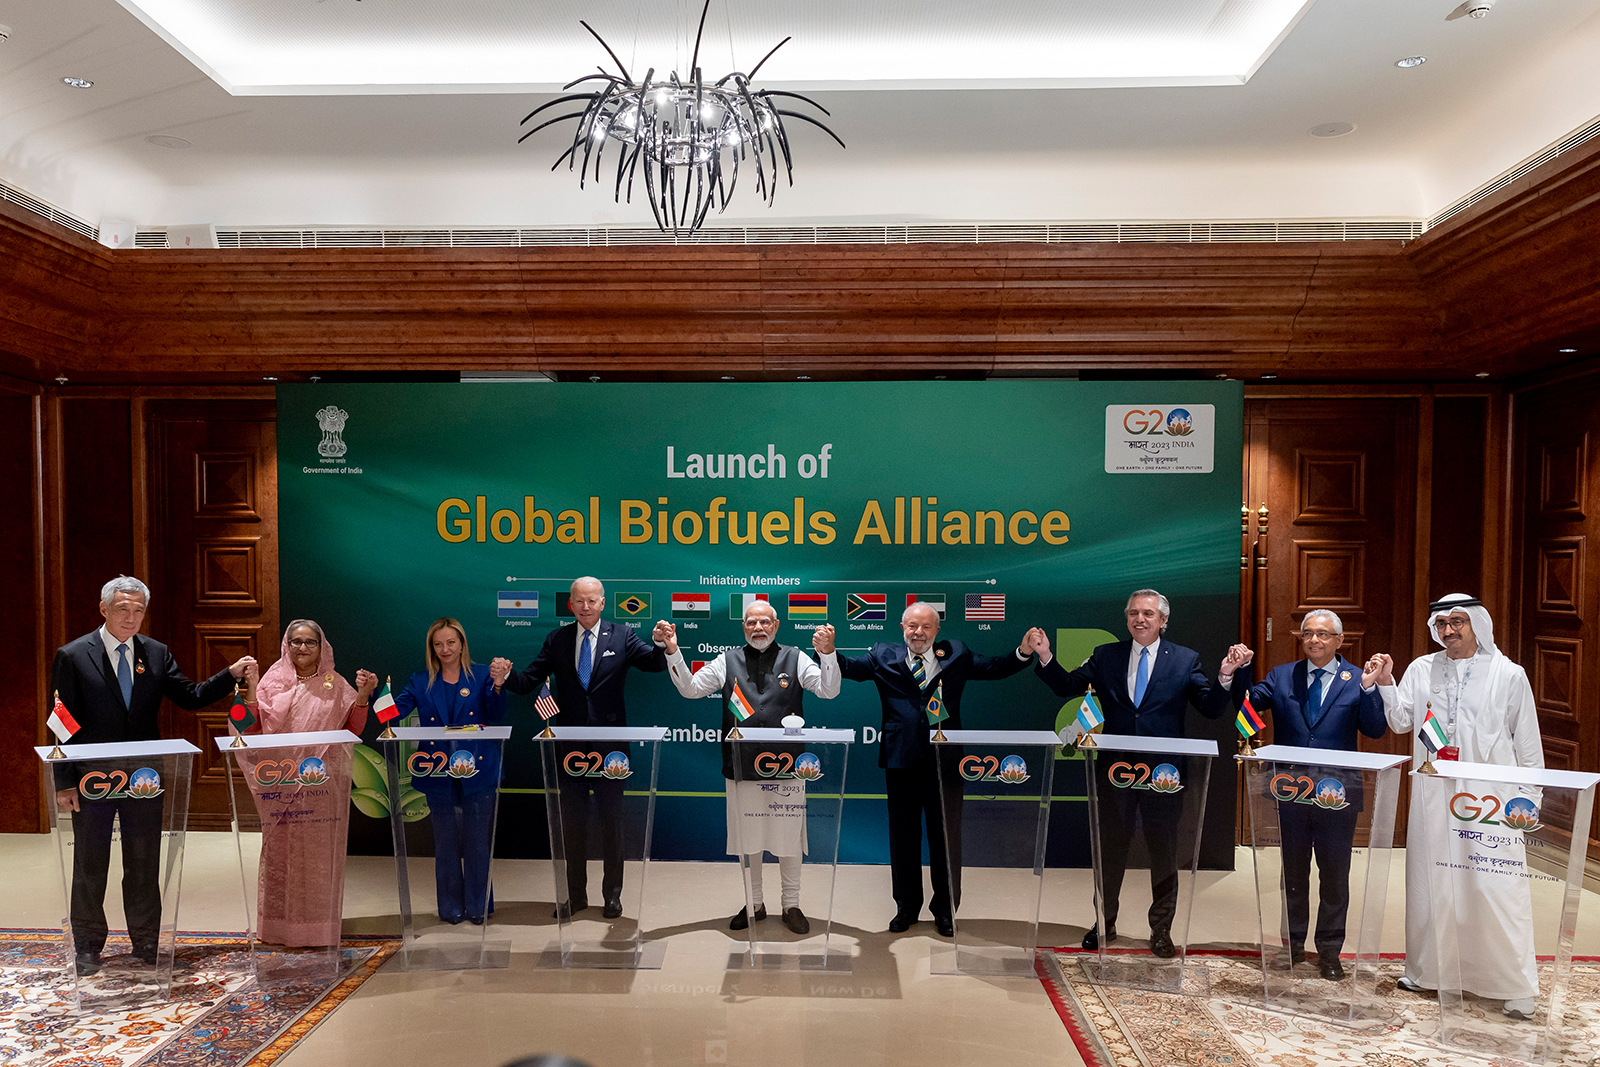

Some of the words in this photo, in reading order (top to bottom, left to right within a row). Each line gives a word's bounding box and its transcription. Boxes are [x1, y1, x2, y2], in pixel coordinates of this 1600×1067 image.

[1123, 408, 1195, 436] G20
[667, 444, 787, 479] Launch
[797, 443, 833, 479] of
[1151, 442, 1170, 450] 2023
[303, 466, 339, 474] Government
[436, 495, 600, 545] Global
[619, 495, 837, 546] Biofuels
[853, 496, 1071, 546] Alliance
[700, 575, 747, 588] Initiating
[750, 575, 800, 586] Members
[505, 620, 531, 628] Argentina
[254, 756, 330, 787] G20
[407, 750, 480, 779] G20
[563, 750, 633, 780] G20
[754, 751, 824, 781] G20
[958, 754, 1031, 784] G20
[1108, 761, 1184, 794] G20
[79, 767, 165, 800] G20
[1270, 773, 1350, 811] G20
[1449, 792, 1545, 833] G20
[1487, 835, 1511, 846] 2023
[1514, 837, 1544, 847] INDIA
[1491, 868, 1512, 876] FAMILY
[1535, 874, 1559, 882] FUTURE
